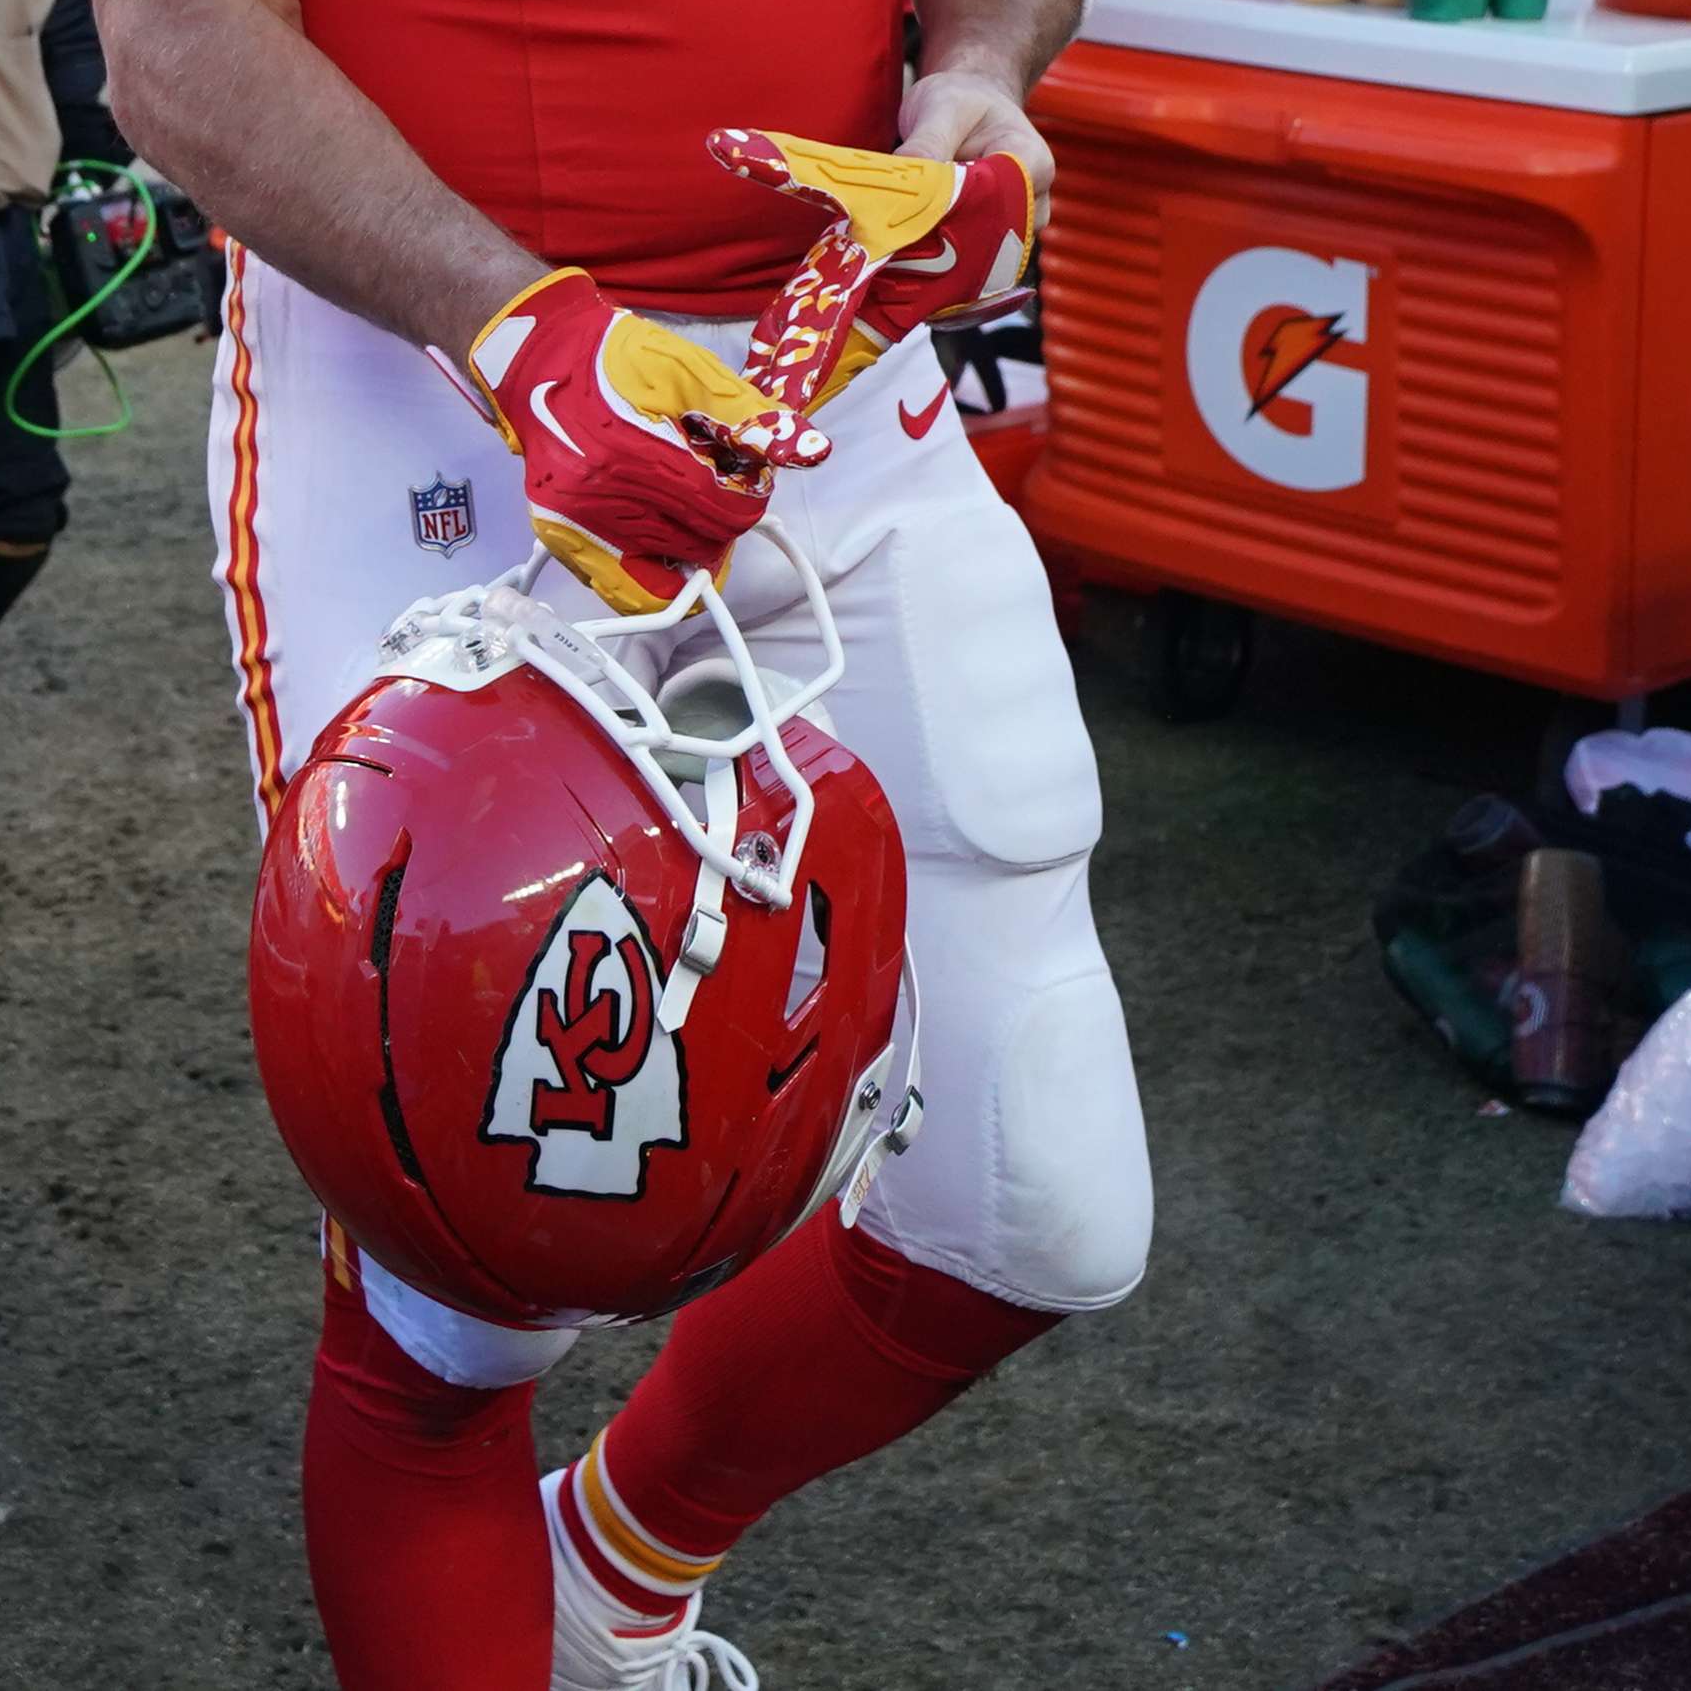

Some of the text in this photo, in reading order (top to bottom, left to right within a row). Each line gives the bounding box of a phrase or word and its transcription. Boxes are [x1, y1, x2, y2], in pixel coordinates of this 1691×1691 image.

[1186, 245, 1369, 492] G
[422, 510, 467, 542] NFL
[530, 930, 655, 1142] KC
